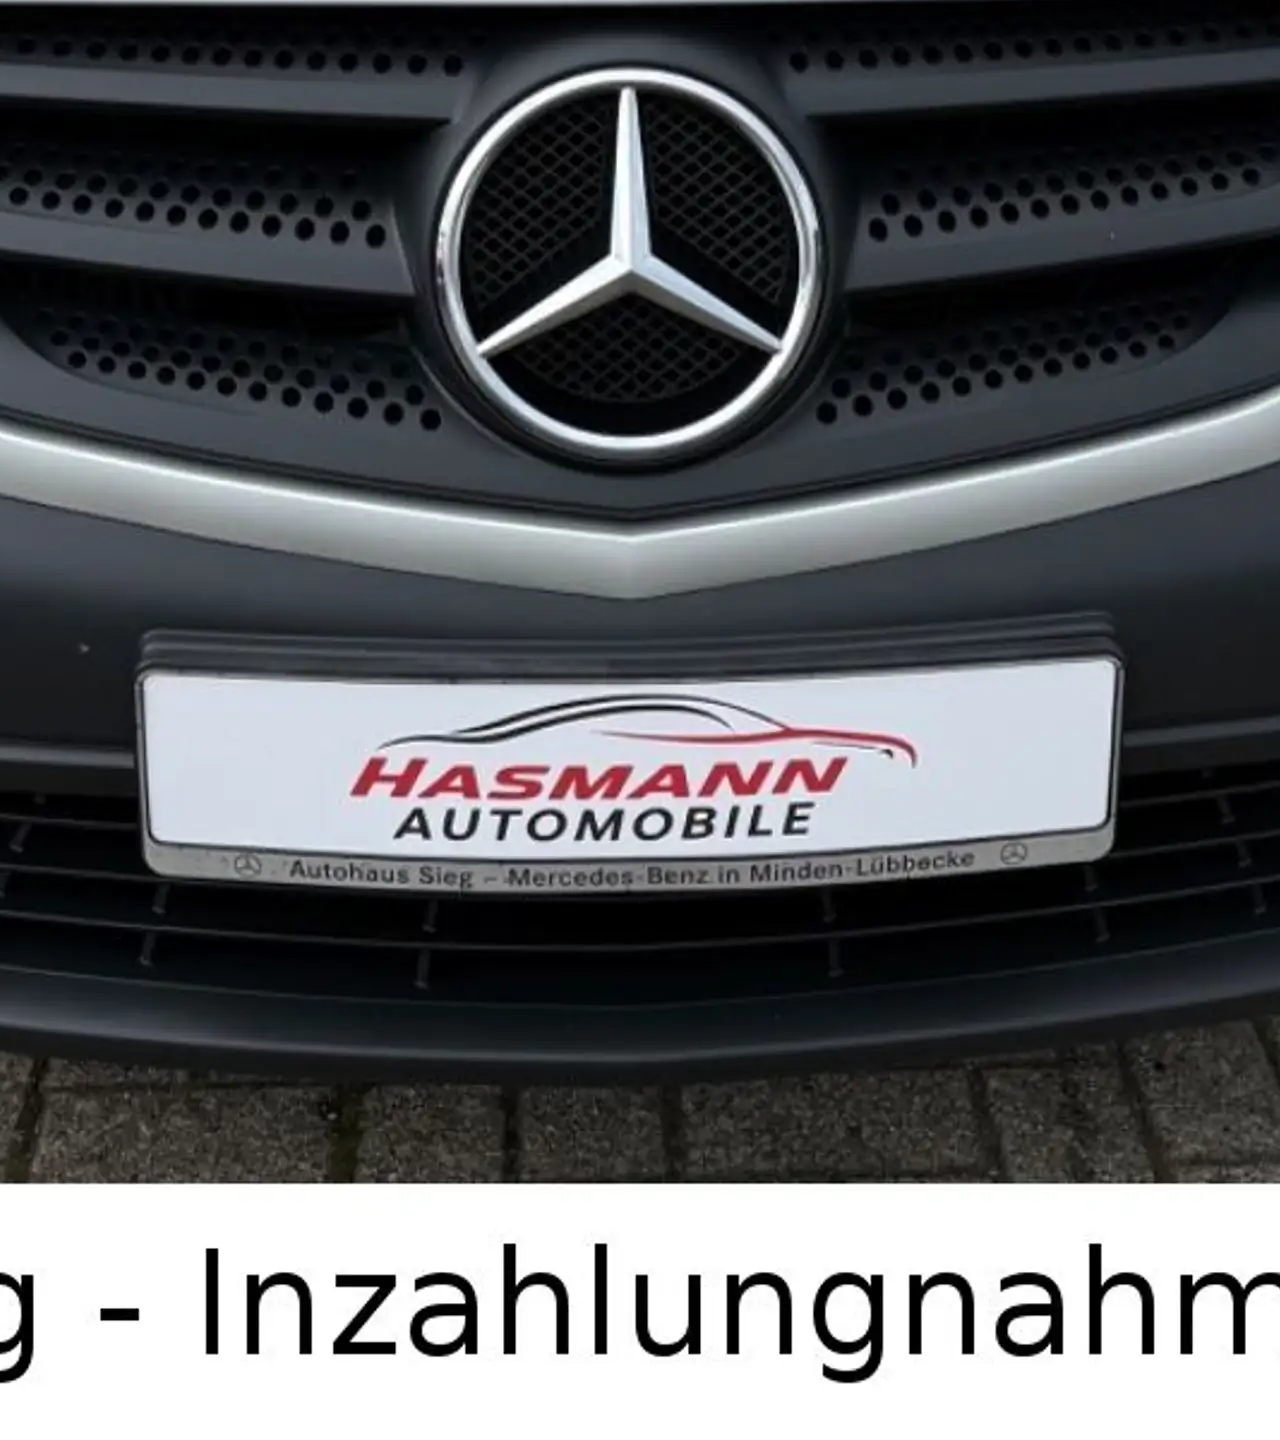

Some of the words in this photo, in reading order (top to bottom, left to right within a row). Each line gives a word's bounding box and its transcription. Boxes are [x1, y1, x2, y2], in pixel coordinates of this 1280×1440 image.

[349, 756, 849, 801] HASMANN
[393, 801, 816, 842] AUTOMOBILE
[289, 859, 411, 886] Autohaus
[418, 864, 474, 889] Sieg
[506, 864, 710, 888] Mercedes-Benz
[719, 862, 741, 885] in
[749, 849, 976, 883] Minden-Lübbecke
